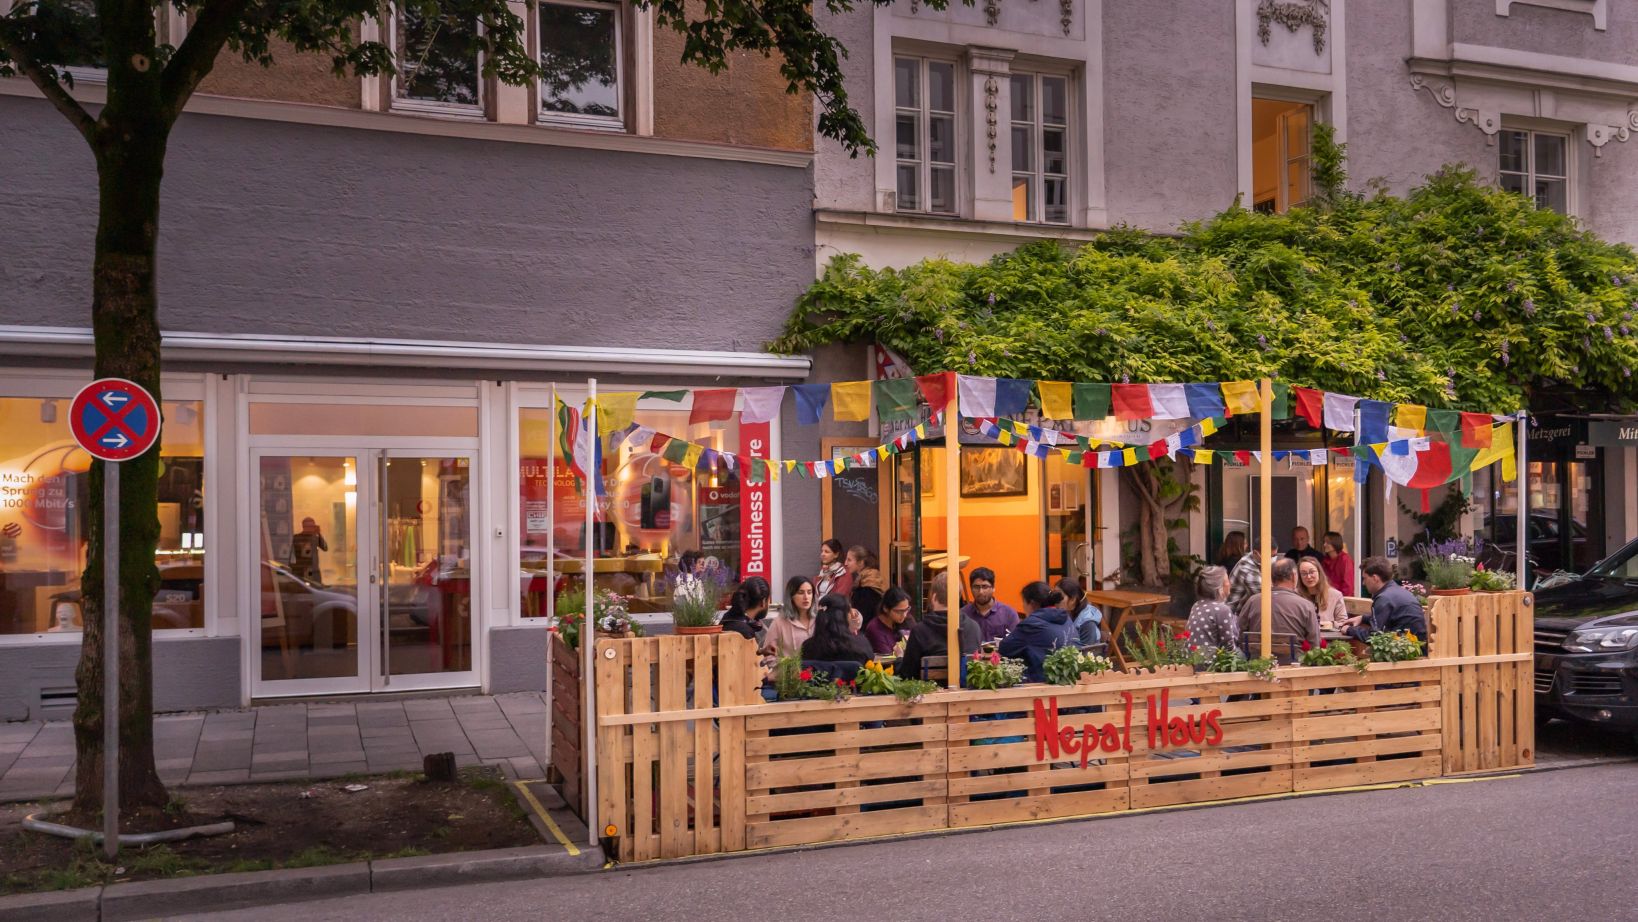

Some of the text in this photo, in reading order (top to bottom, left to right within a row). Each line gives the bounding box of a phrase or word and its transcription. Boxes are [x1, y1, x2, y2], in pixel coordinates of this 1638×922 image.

[3, 474, 60, 483] Mach den
[48, 488, 63, 496] zu
[35, 498, 75, 508] Mbit/s
[746, 438, 764, 573] Business Sre
[1033, 688, 1223, 769] Nepal Haus
